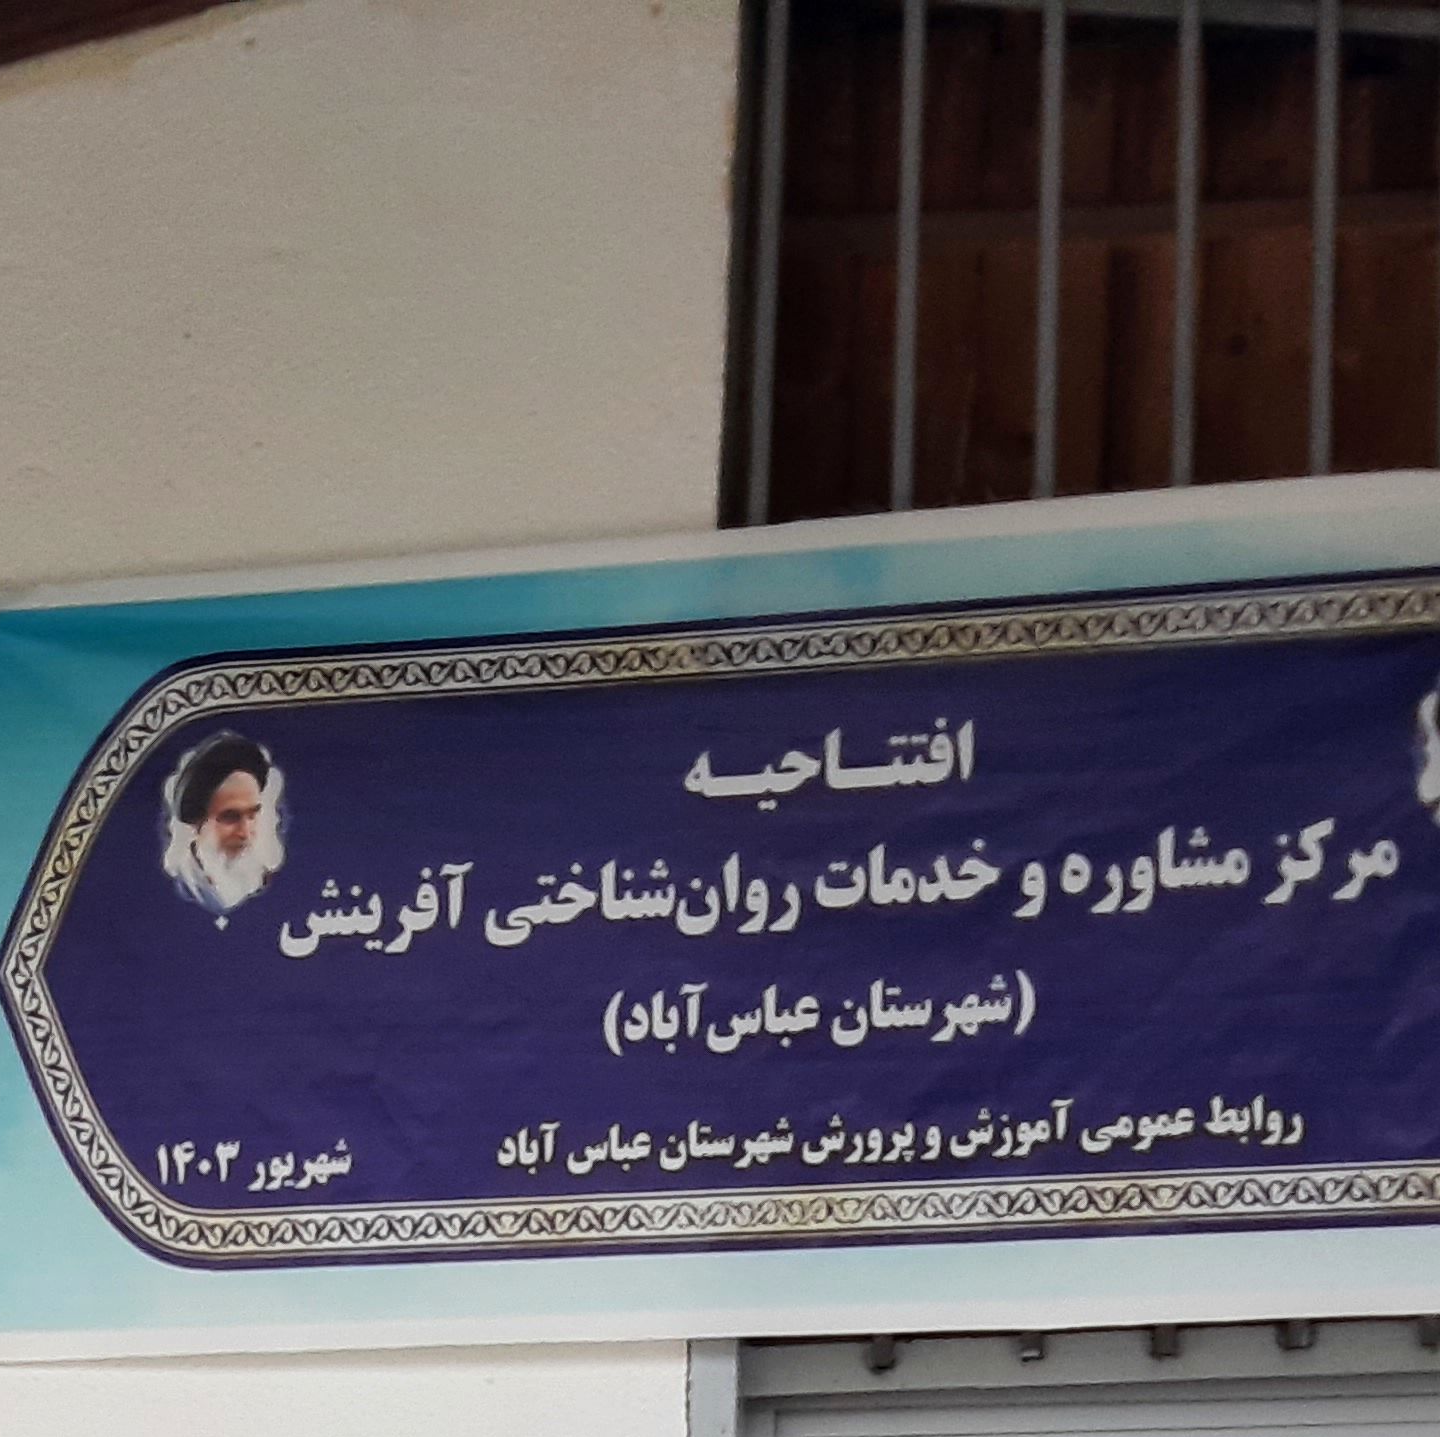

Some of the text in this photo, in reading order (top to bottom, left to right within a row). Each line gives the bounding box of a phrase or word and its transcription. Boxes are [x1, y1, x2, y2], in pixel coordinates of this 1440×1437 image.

[816, 837, 1001, 907] خدمات
[1013, 857, 1048, 918] و
[1059, 826, 1252, 914] مشاوره
[1265, 818, 1400, 904] مرکز
[278, 862, 475, 958] آفرینش
[830, 968, 1037, 1047] (شهرستان
[156, 1138, 354, 1192] شهریور ۱۴۰۳
[496, 1094, 1305, 1174] روابط عمومی آموزش و پرورش شهرستان عباس آباد
